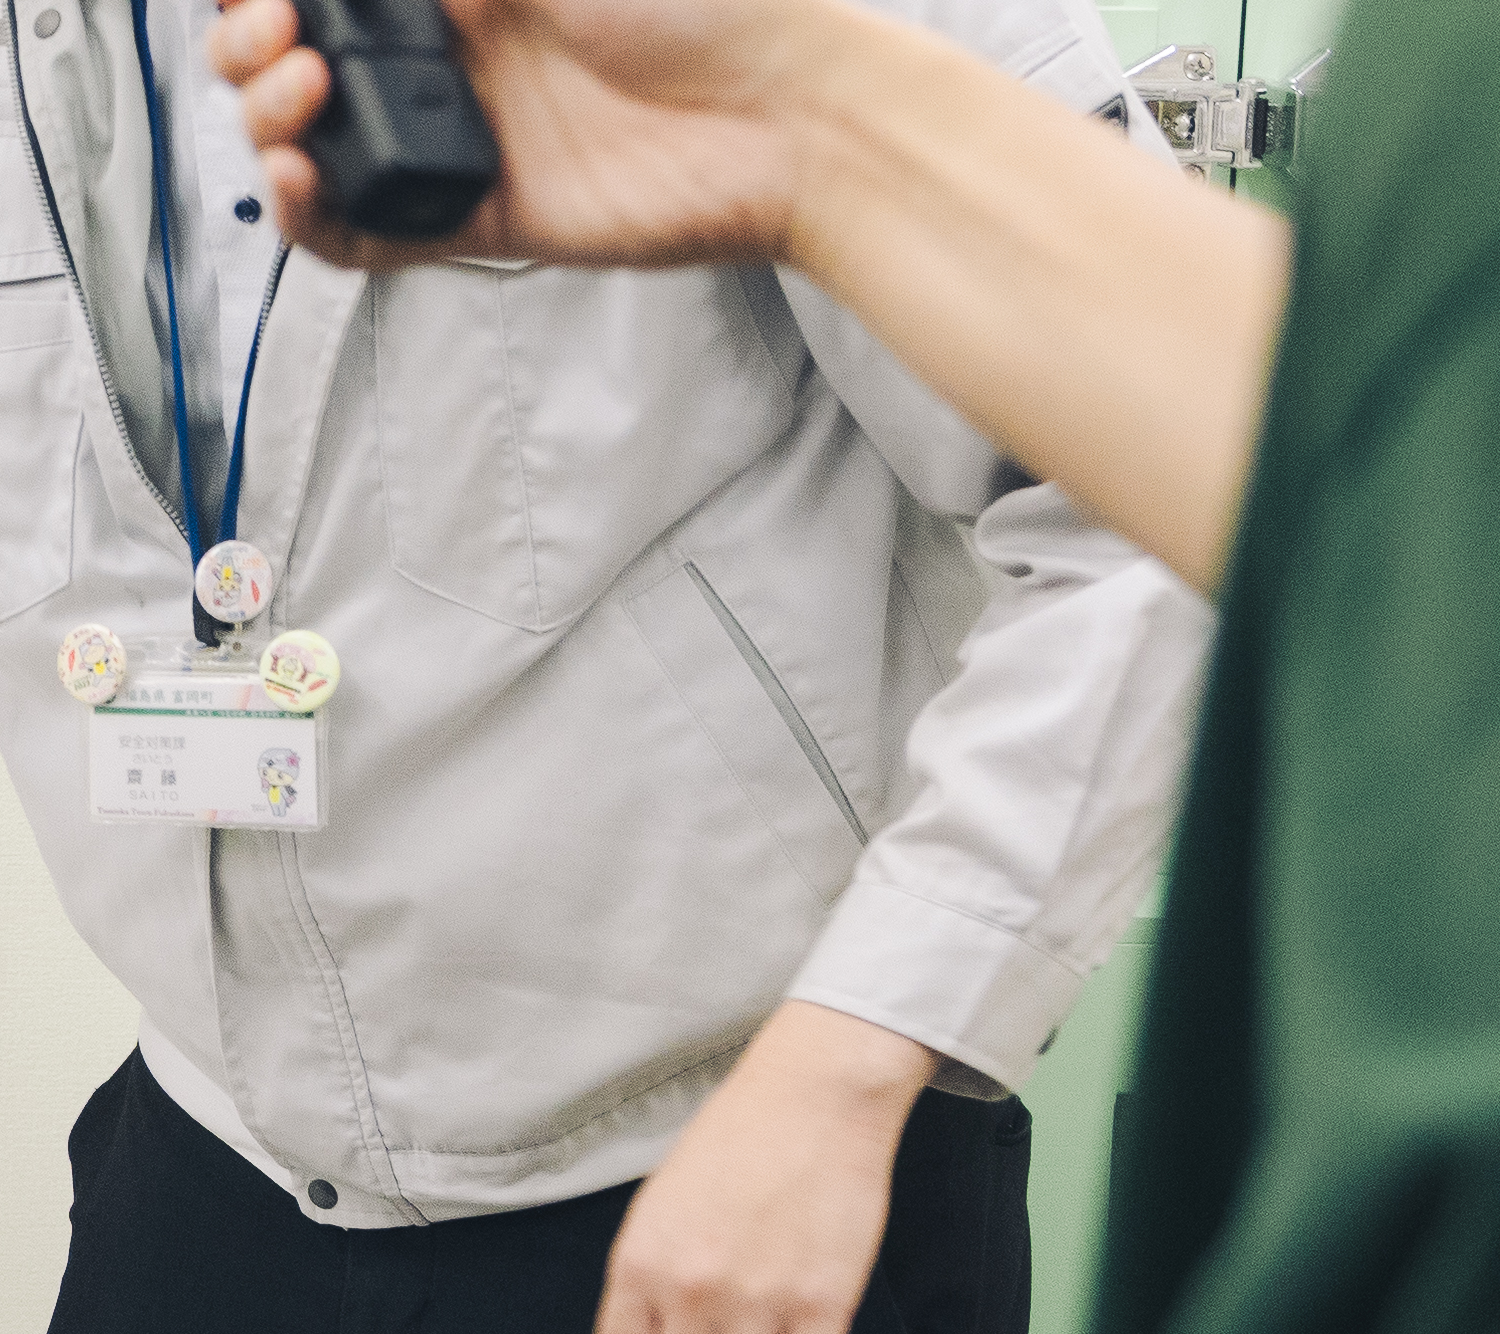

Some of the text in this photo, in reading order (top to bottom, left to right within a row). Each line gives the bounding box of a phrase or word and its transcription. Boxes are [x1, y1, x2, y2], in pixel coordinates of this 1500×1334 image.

[172, 689, 214, 705] 富岡町
[129, 790, 180, 802] SAITO
